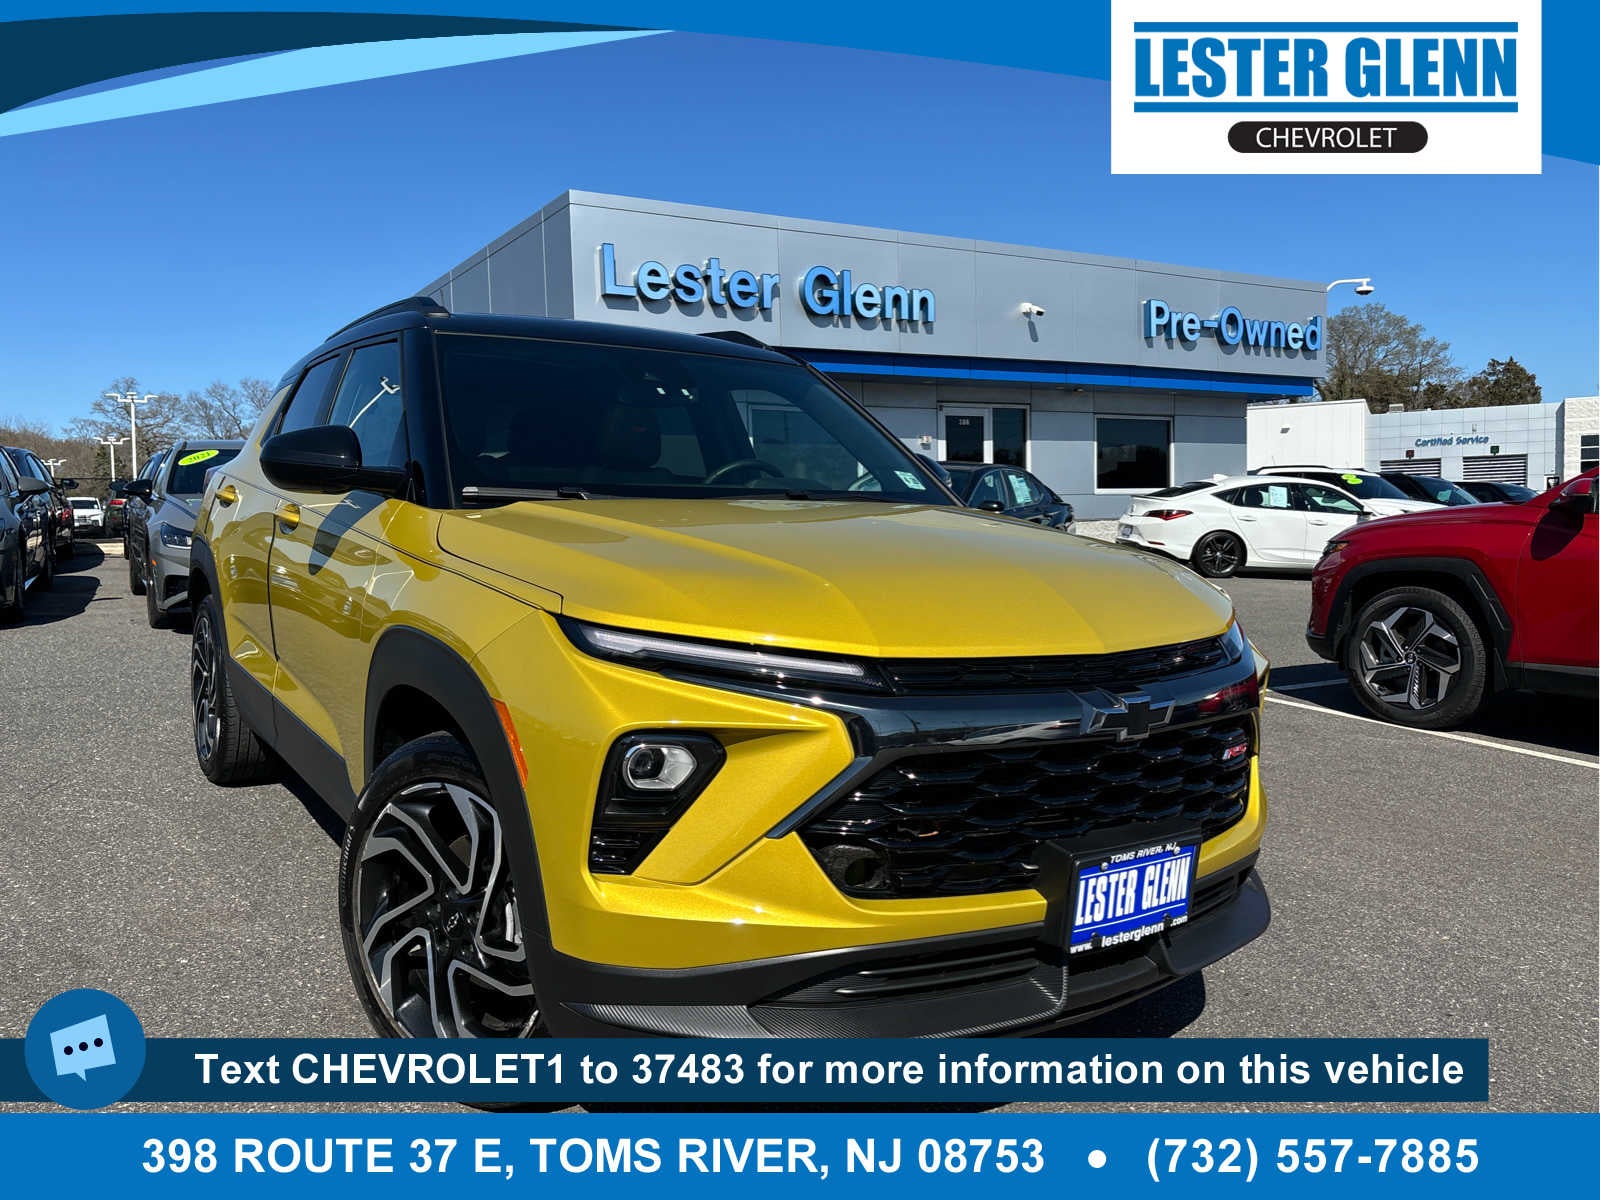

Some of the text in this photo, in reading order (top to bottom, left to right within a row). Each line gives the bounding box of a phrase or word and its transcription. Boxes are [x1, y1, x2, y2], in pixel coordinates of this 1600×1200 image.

[600, 242, 935, 322] Lester Glenn
[1145, 299, 1322, 351] Pre-Owned
[1415, 434, 1490, 448] Certified Service
[1110, 850, 1136, 864] TOMS
[1074, 856, 1191, 926] LESTER GLENN
[1101, 922, 1165, 948] lesterglenn
